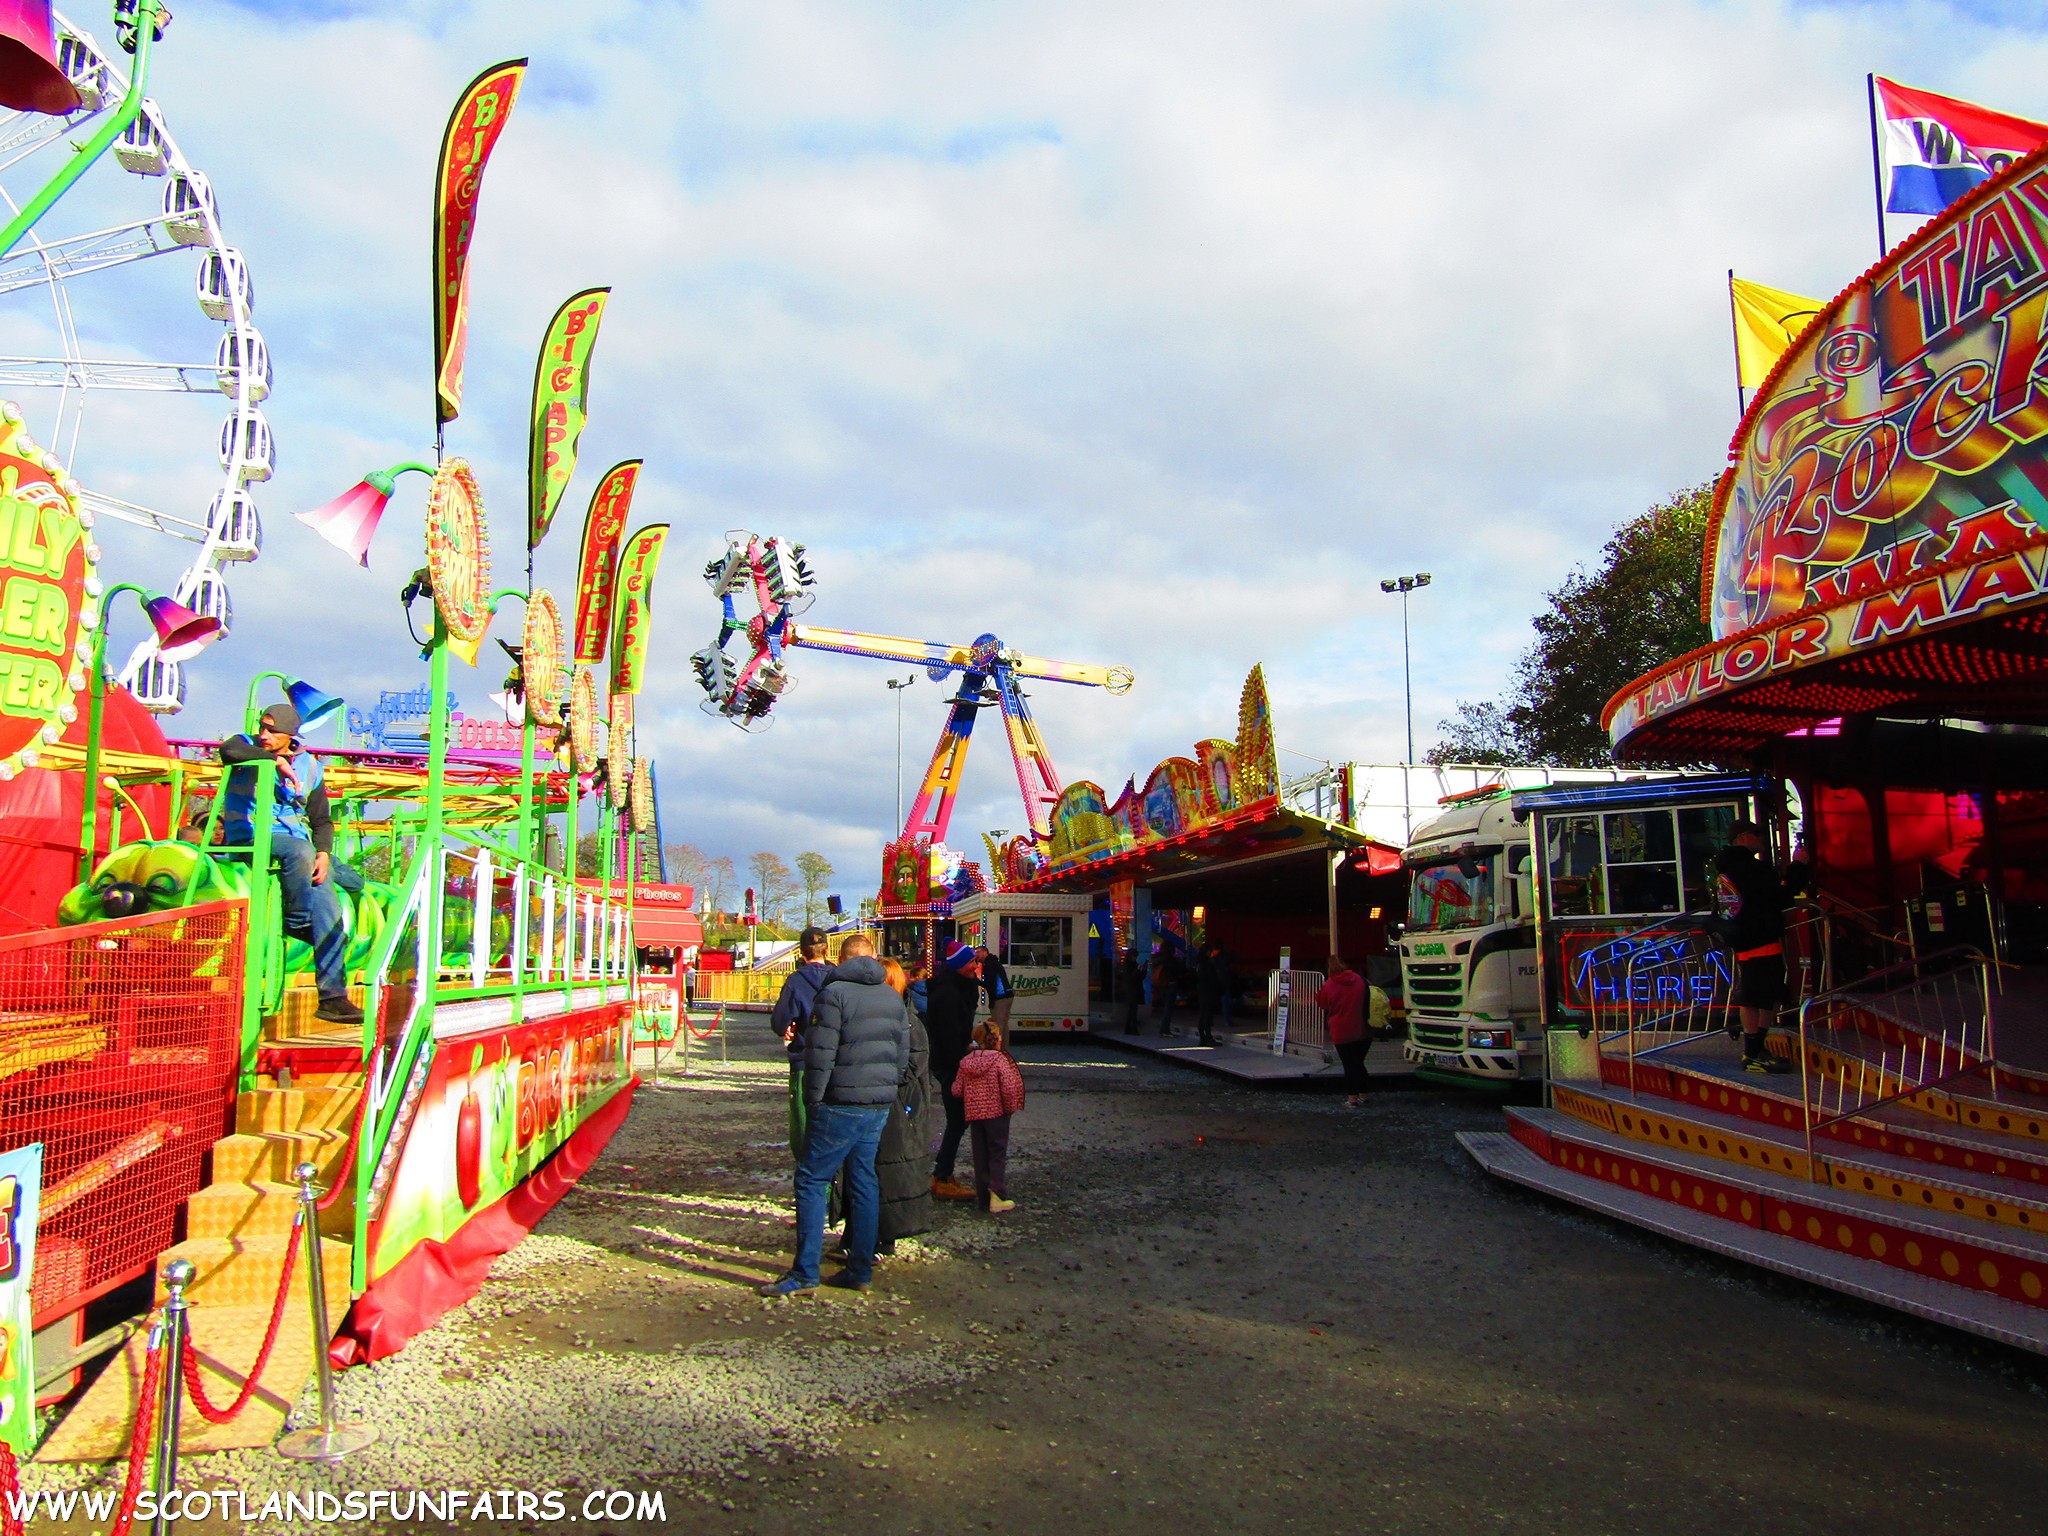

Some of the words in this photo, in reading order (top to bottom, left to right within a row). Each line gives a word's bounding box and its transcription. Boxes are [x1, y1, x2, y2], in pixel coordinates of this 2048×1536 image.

[551, 310, 588, 392] BIG
[595, 477, 625, 544] BIG
[627, 538, 653, 592] BIG
[584, 551, 610, 657] APPLE
[1633, 613, 1830, 721] TAYLOR
[1849, 547, 2048, 645] MA
[618, 598, 640, 687] APPLE
[634, 887, 682, 901] Photos
[1414, 943, 1446, 956] SCANIA
[1610, 940, 1688, 964] PAY
[1593, 976, 1714, 1001] HERE
[516, 1050, 562, 1154] BIG
